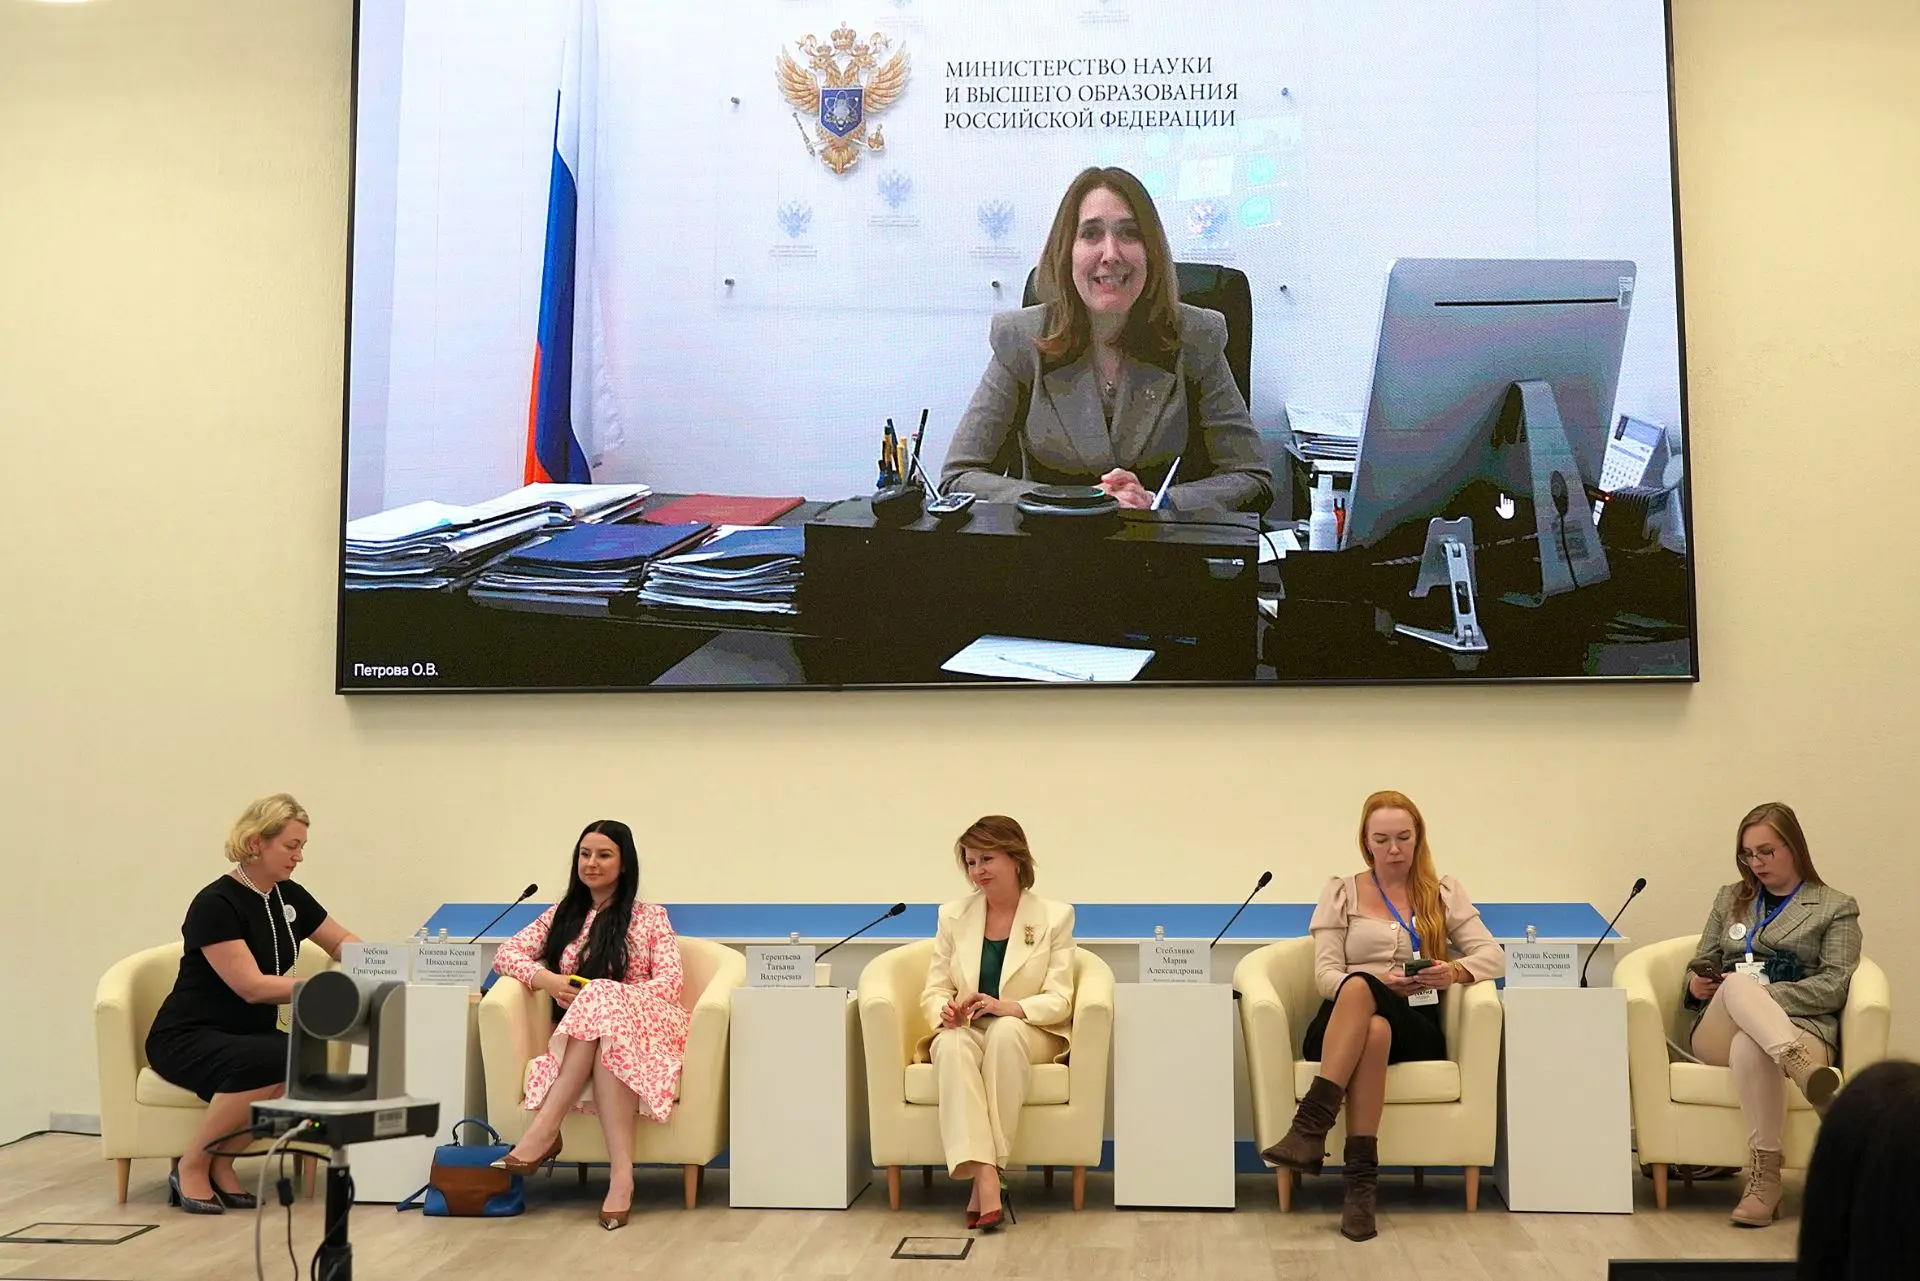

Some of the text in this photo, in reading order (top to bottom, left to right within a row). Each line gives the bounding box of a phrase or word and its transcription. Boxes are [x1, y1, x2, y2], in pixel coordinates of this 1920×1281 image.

[946, 57, 1213, 78] МИНИСТЕРСТВО НАУКИ
[945, 83, 1239, 103] И ВЫСШЕГО ОБРАЗОВАНИЯ
[944, 107, 1237, 130] РОССИЙСКОЙ ФЕДЕРАЦИИ
[354, 663, 439, 679] Петрова О.В.
[449, 948, 476, 956] Ксения
[1512, 951, 1570, 960] Орлова Ксения
[760, 953, 801, 961] Терентьева
[1163, 957, 1187, 965] Мария
[425, 958, 469, 966] Николаевна
[1513, 961, 1571, 971] Александровна
[352, 967, 398, 977] Григорьевна
[1147, 967, 1204, 975] Александровна
[760, 973, 802, 982] Валерьевна
